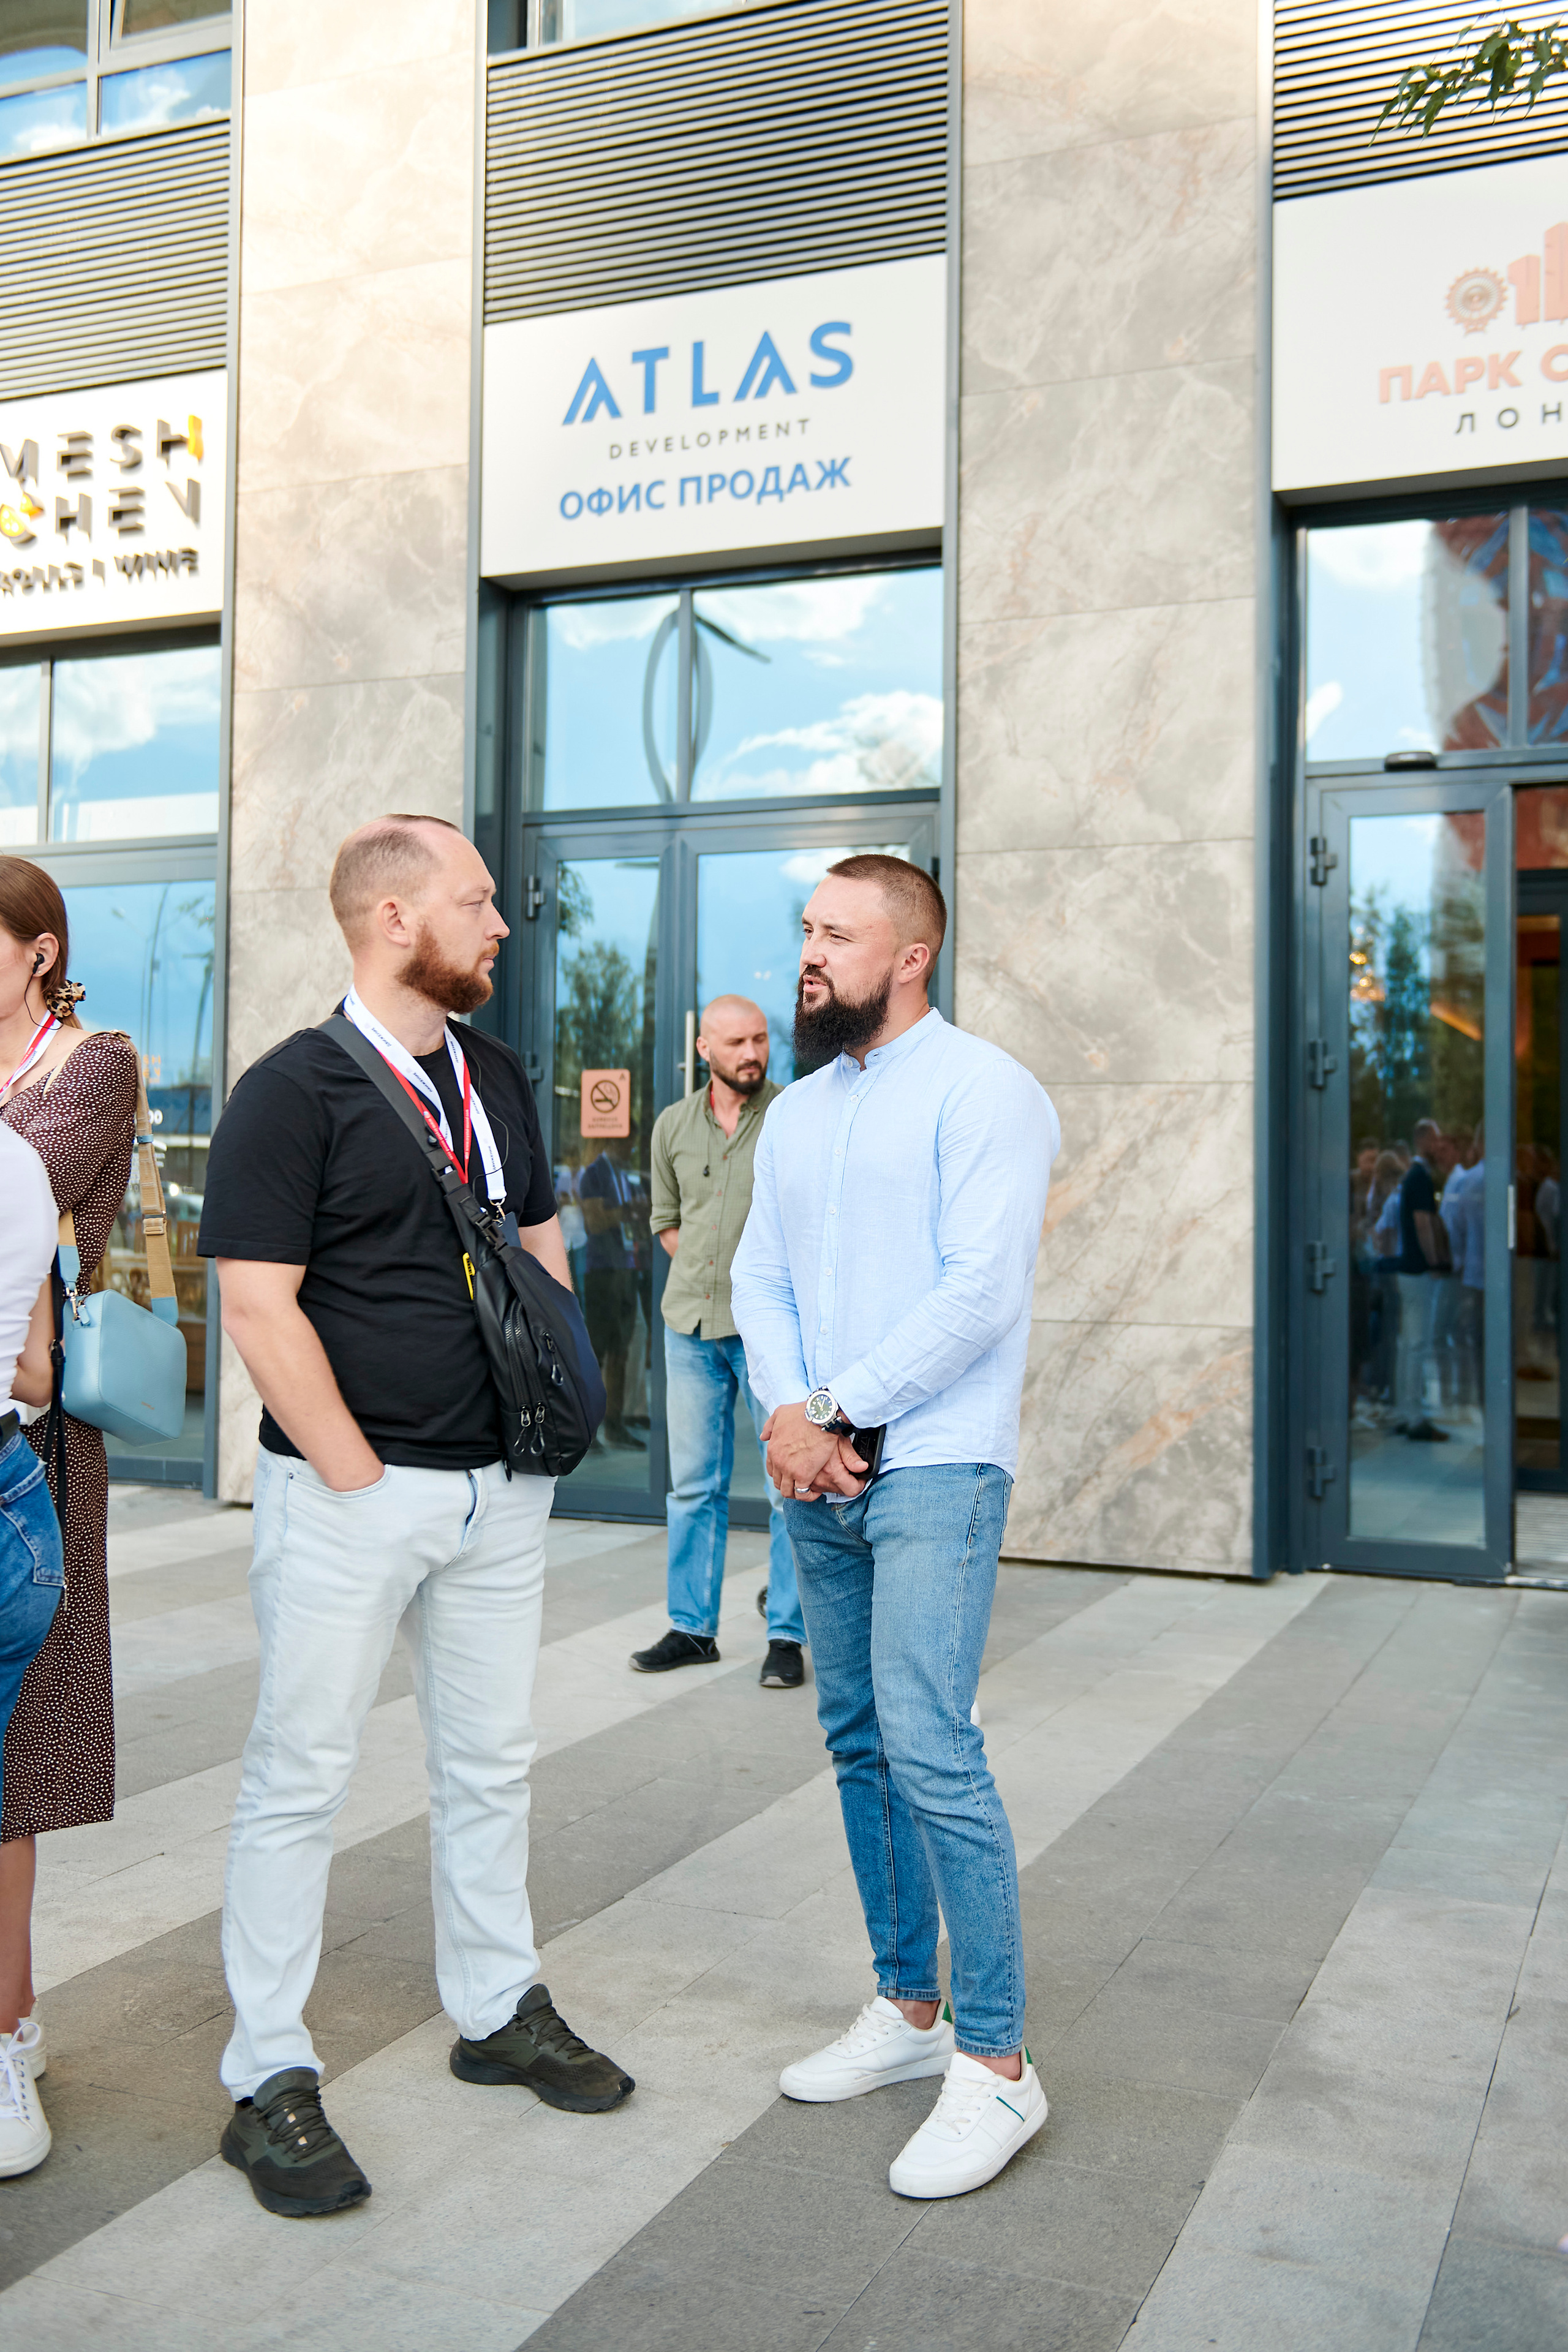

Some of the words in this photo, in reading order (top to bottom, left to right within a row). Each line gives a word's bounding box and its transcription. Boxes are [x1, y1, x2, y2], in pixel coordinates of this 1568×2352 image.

[563, 321, 854, 426] ATLAS
[1379, 350, 1523, 404] ПАРК
[609, 419, 810, 459] DEVELOPMENT
[1455, 402, 1562, 434] ЛОН
[560, 480, 665, 520] ОФИС
[679, 457, 851, 506] ПРОДАЖ
[114, 548, 198, 583] WINE
